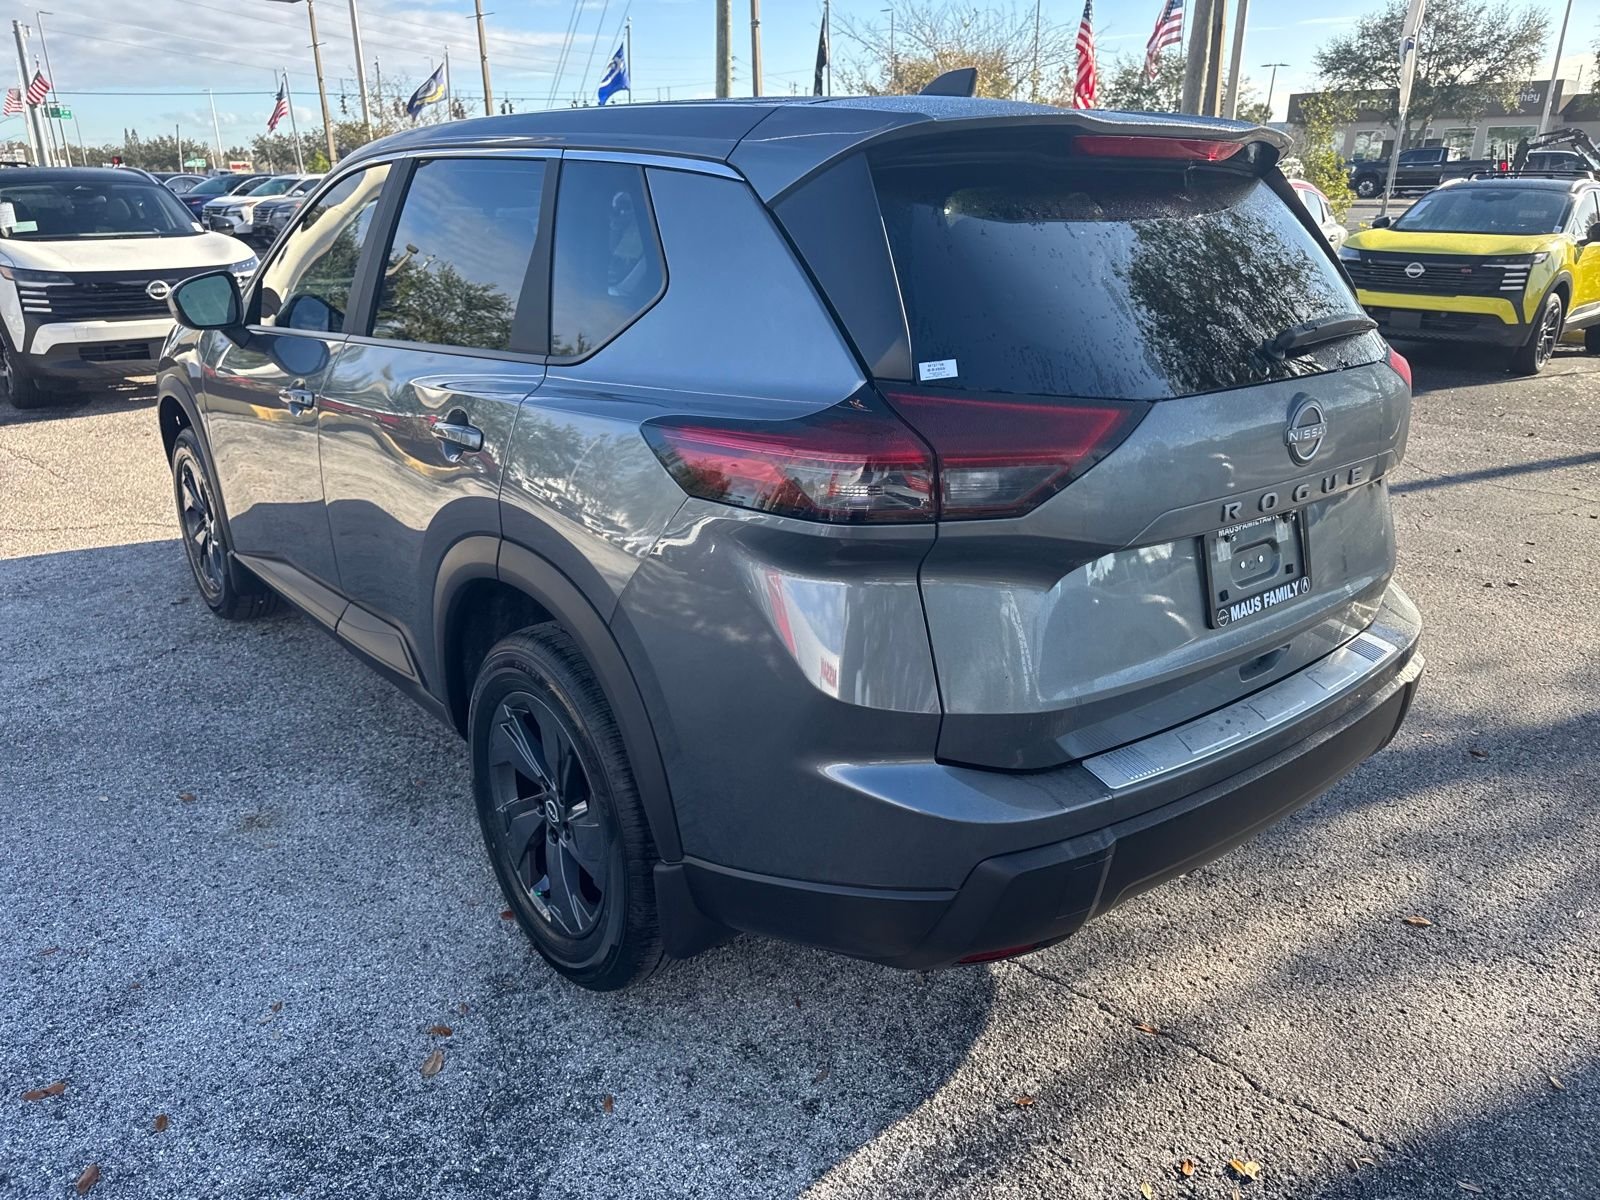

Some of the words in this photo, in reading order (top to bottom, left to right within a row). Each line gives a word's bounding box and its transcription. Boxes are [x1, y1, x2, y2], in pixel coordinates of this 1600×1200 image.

[1221, 466, 1364, 522] ROGUE
[1230, 597, 1262, 622] MAUS
[1263, 581, 1300, 608] FAMILY
